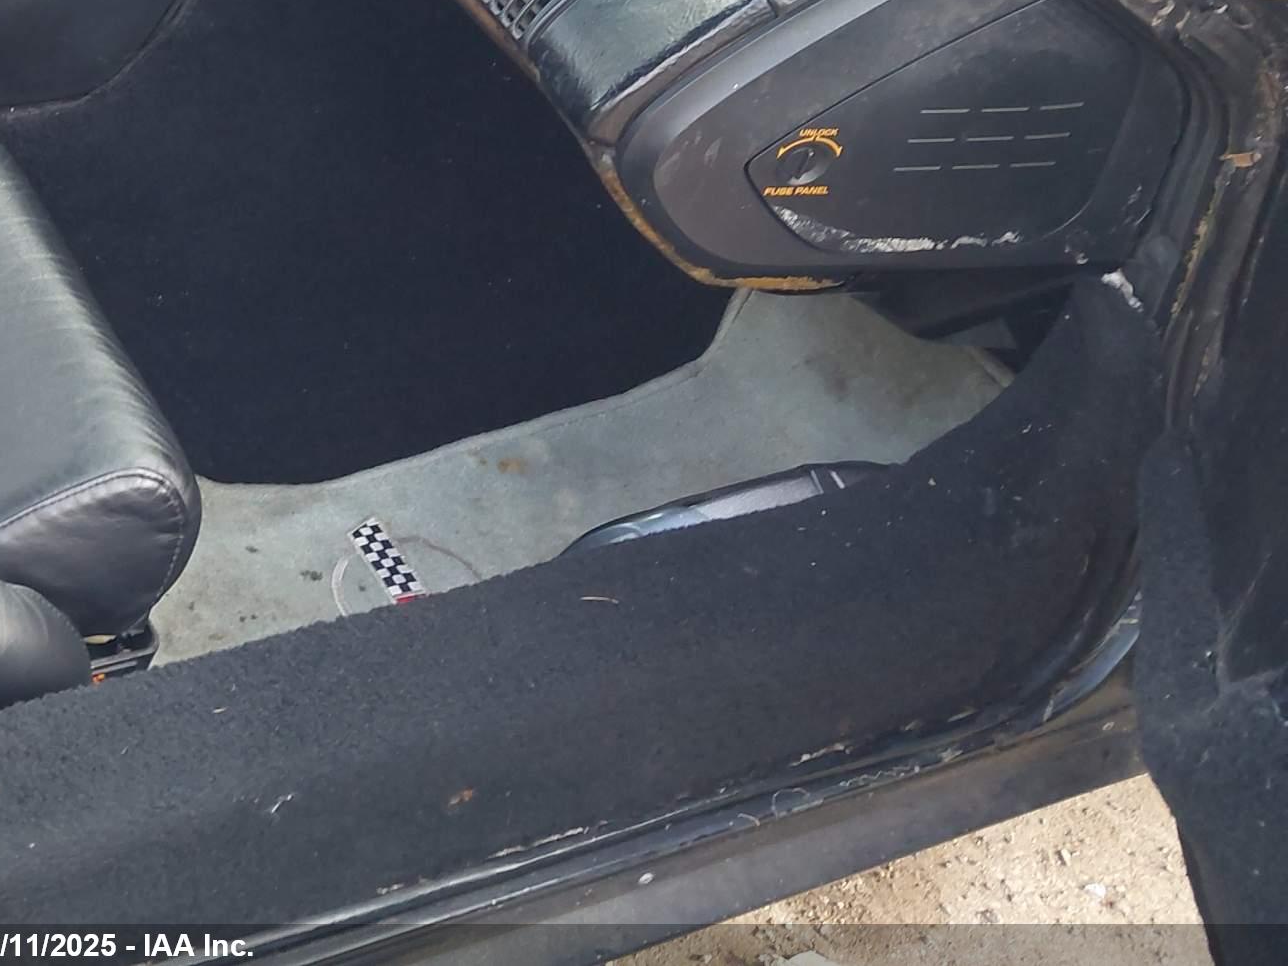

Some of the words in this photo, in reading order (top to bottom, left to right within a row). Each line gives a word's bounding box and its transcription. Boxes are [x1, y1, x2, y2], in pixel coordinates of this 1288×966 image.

[799, 127, 839, 137] UNLOCK
[763, 186, 794, 197] FUSE
[794, 185, 829, 196] PANEL
